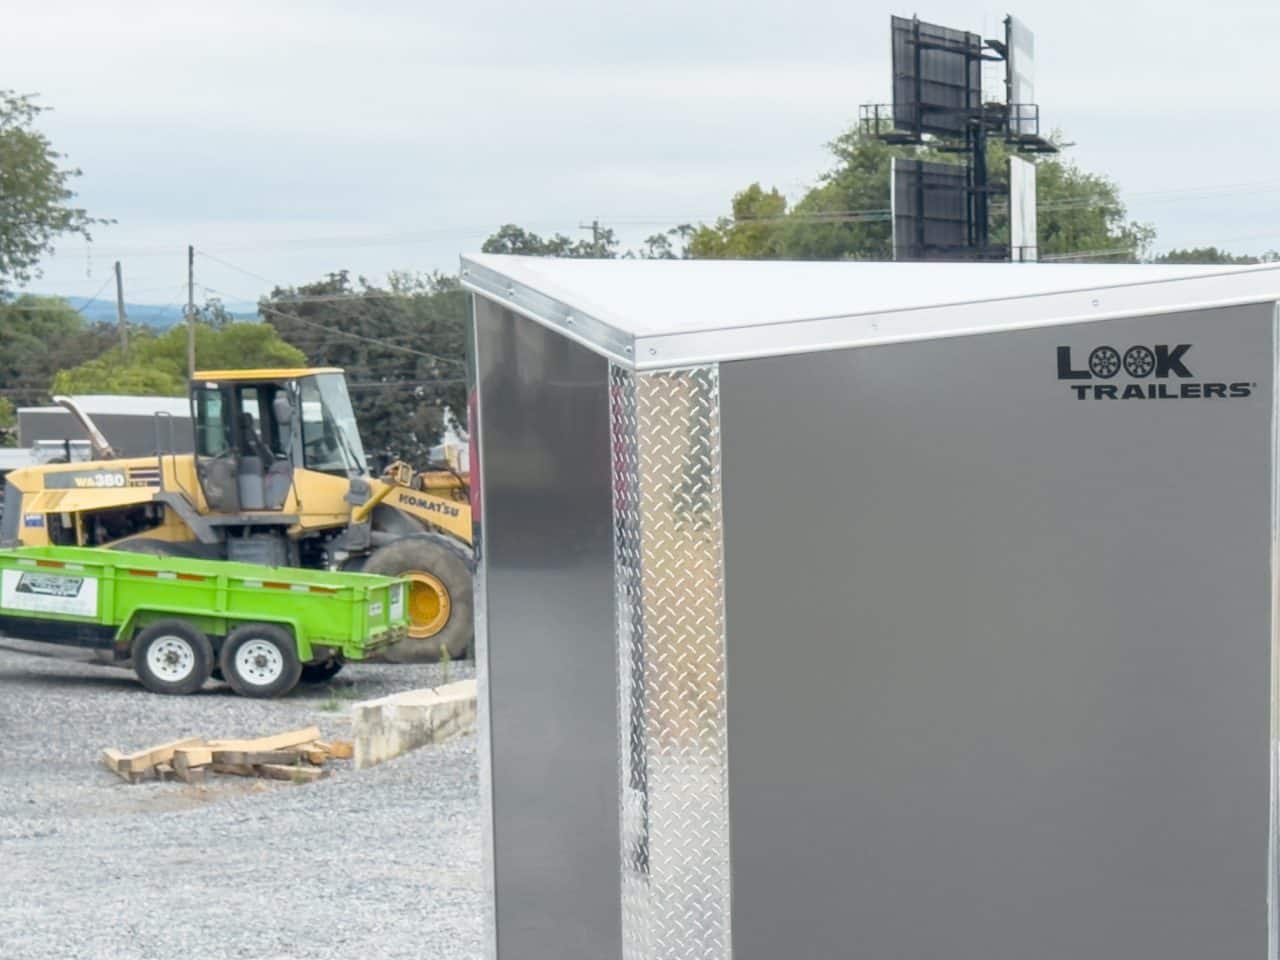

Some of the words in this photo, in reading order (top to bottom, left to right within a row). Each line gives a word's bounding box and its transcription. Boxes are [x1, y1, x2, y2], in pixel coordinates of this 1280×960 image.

[1057, 344, 1193, 380] LOOK
[1070, 383, 1252, 400] TRAILERS
[399, 493, 459, 517] KOMATSU
